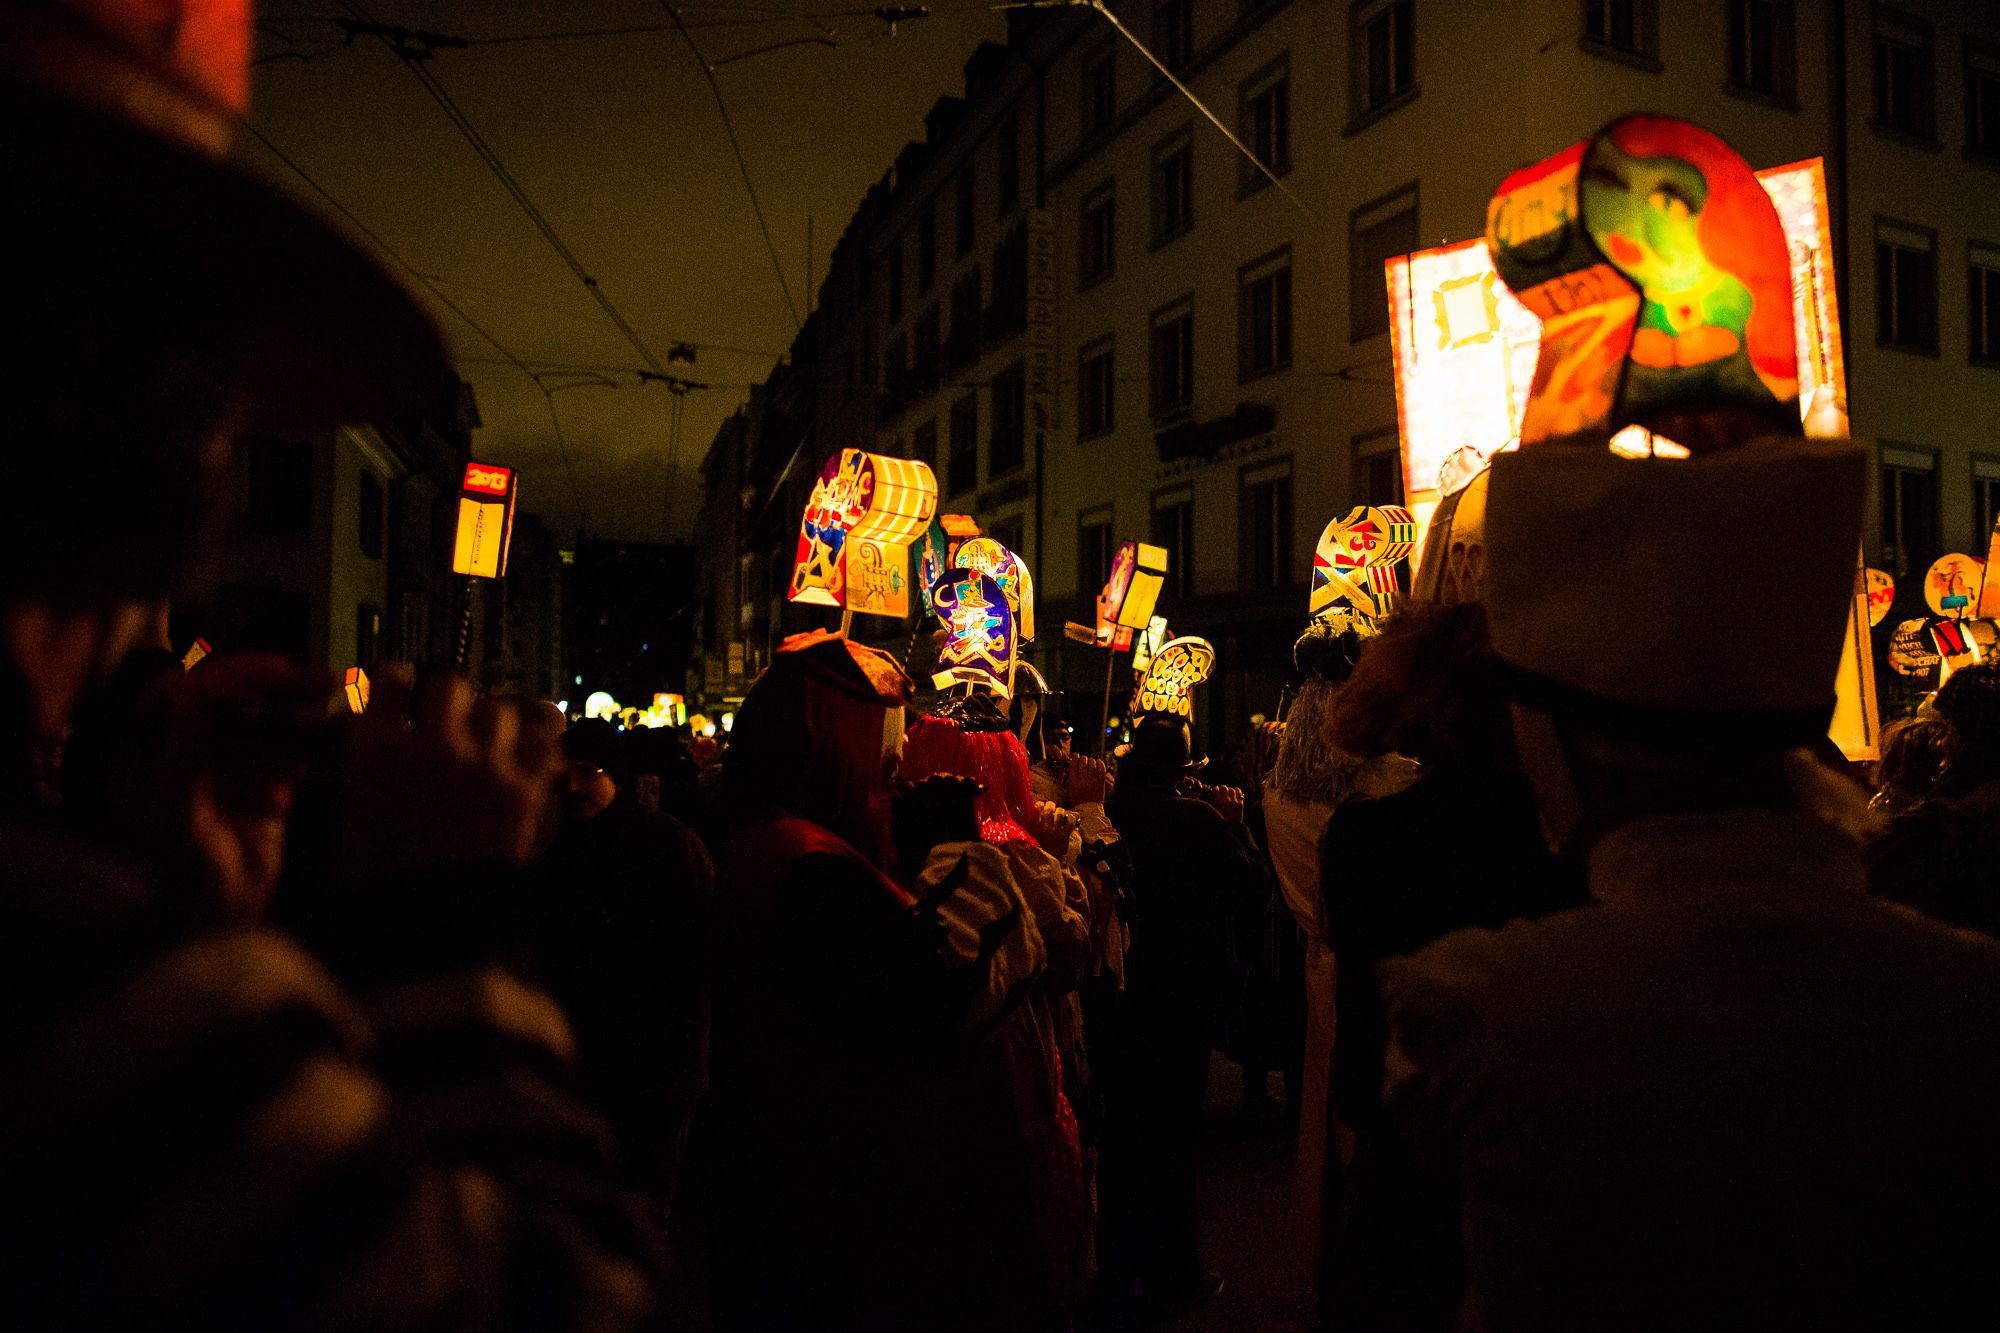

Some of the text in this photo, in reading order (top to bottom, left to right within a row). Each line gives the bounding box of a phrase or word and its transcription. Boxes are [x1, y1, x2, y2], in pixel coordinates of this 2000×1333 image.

[1031, 214, 1052, 393] Manpower
[467, 469, 507, 490] 2013
[1141, 548, 1165, 566] 2013
